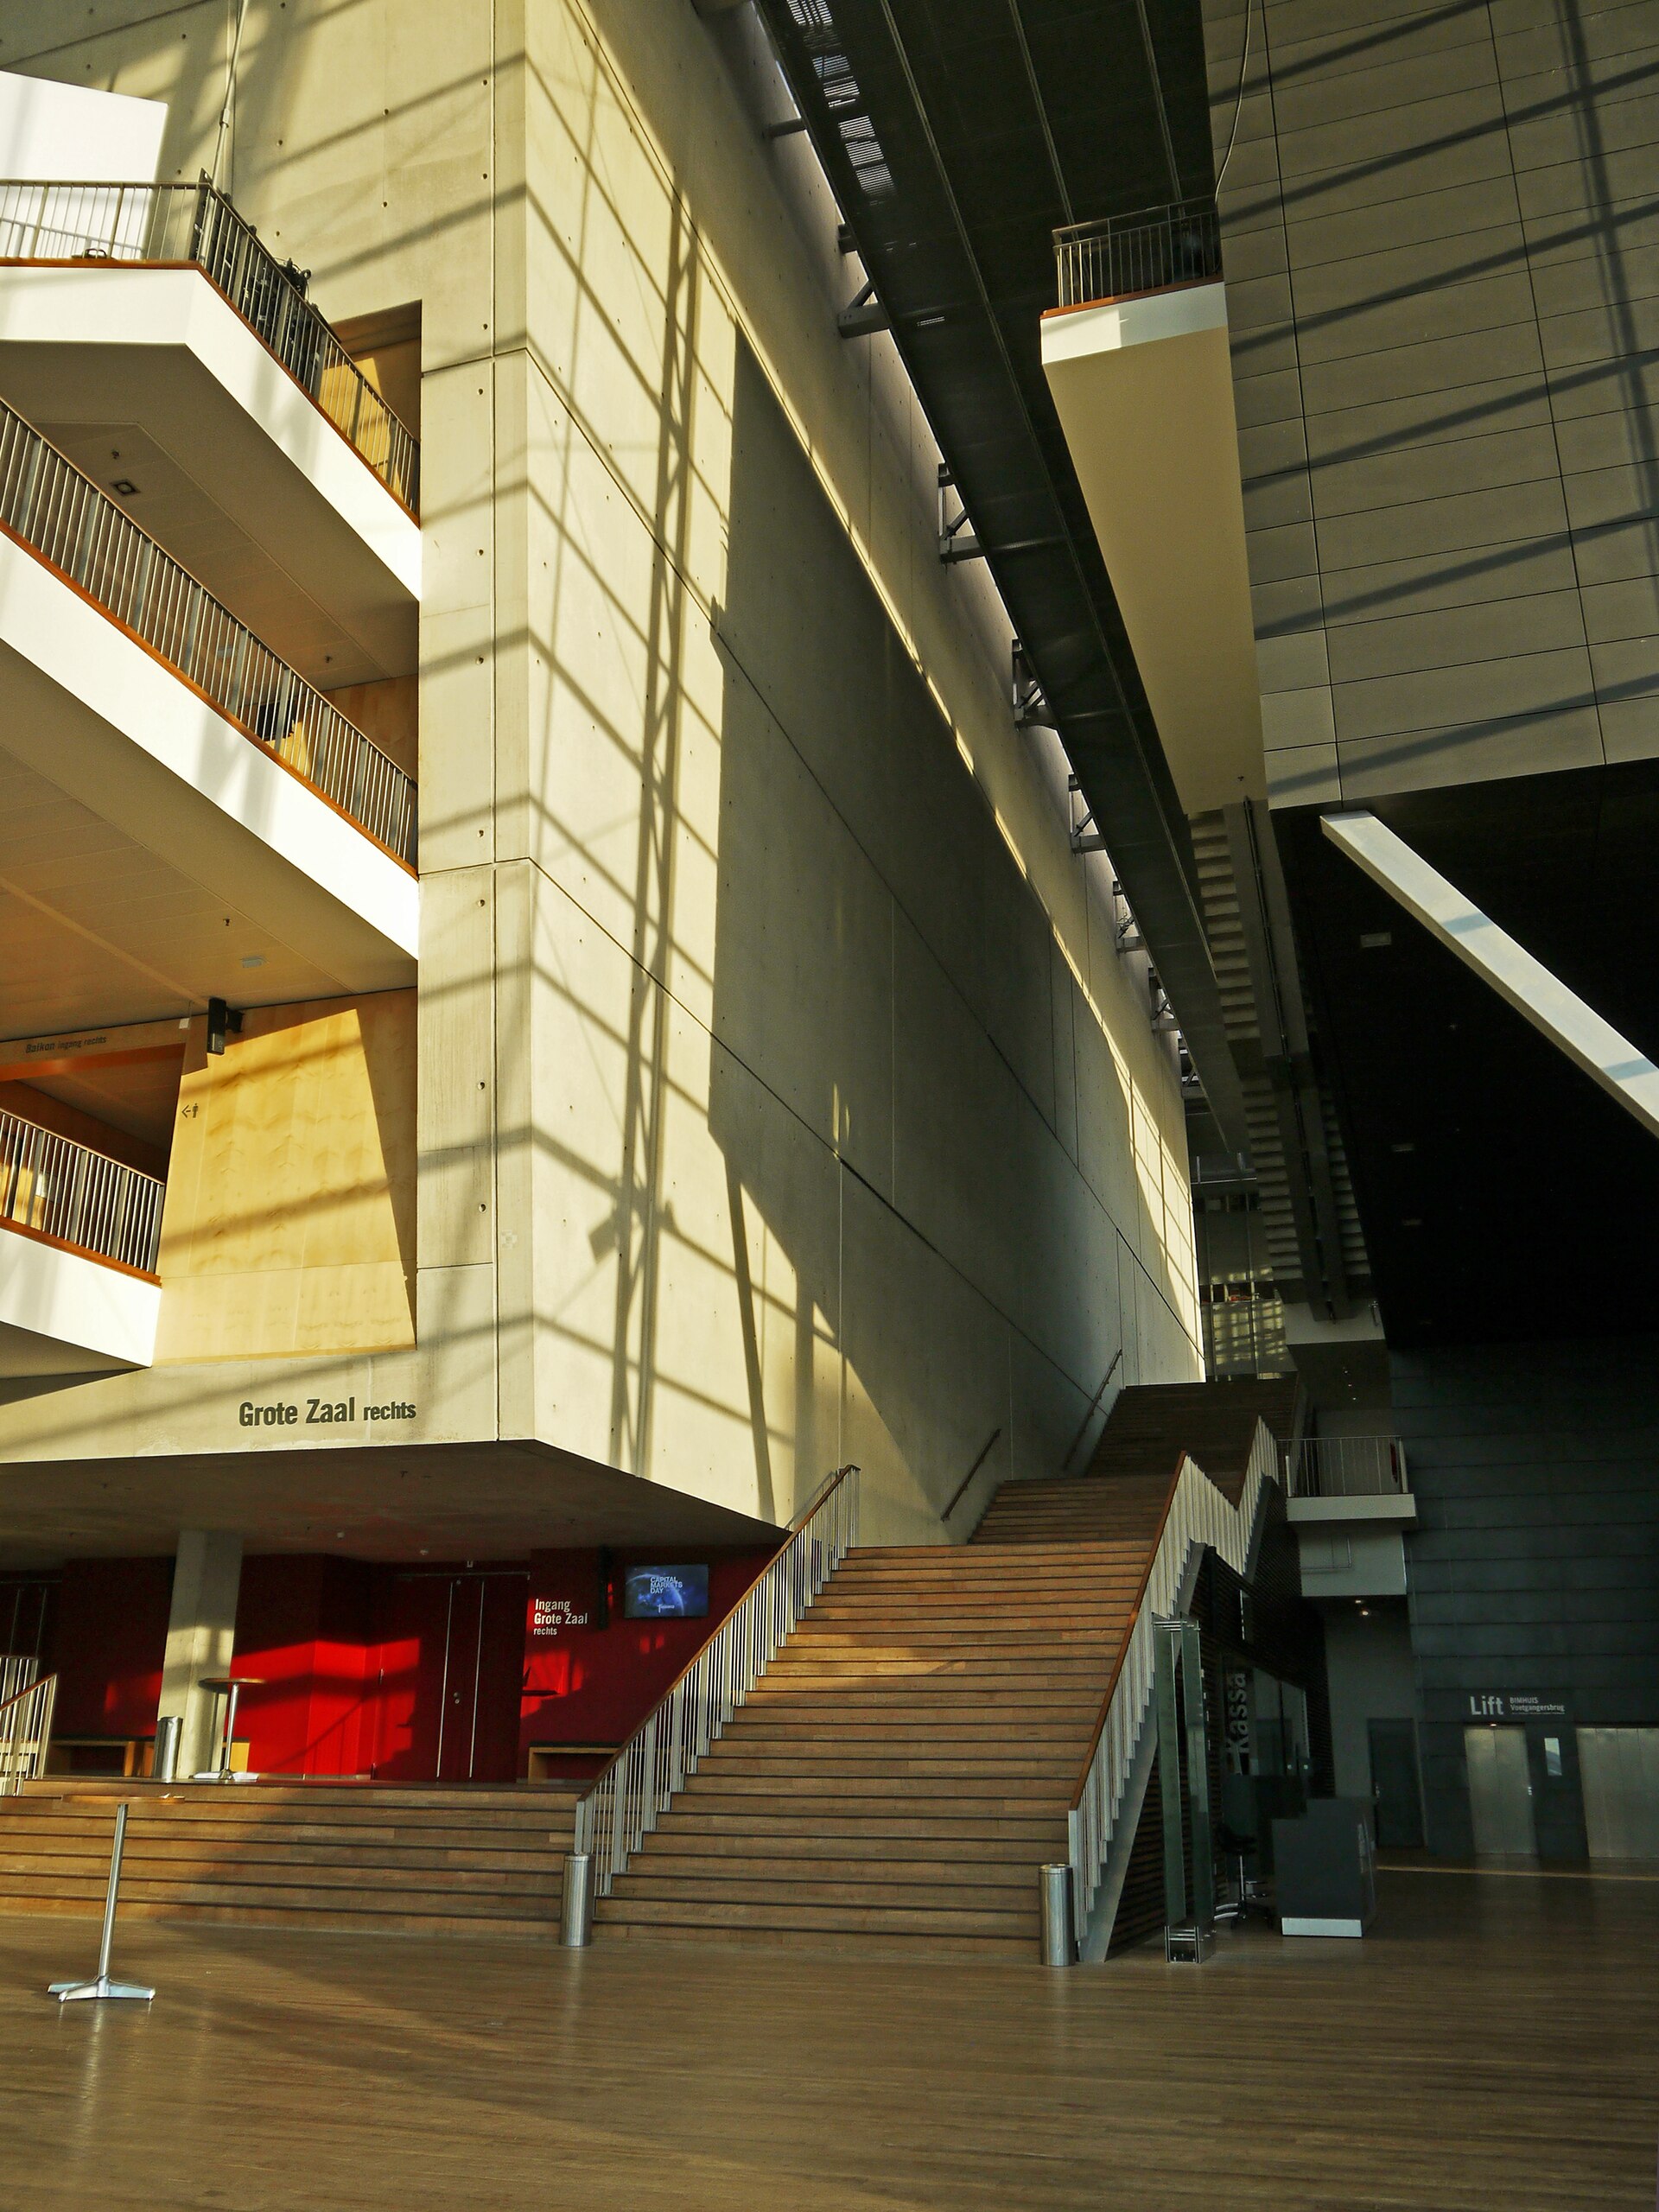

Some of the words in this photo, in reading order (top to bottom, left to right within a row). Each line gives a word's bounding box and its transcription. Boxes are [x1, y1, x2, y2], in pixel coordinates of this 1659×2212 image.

[25, 1042, 55, 1053] Balkon
[238, 1402, 298, 1427] Grote
[305, 1396, 355, 1424] Zaal
[363, 1401, 417, 1421] rechts
[535, 1598, 571, 1613] Ingang
[534, 1611, 562, 1624] Grote
[564, 1612, 588, 1624] Zaal
[533, 1626, 558, 1636] rechts
[1470, 1695, 1504, 1716] Lift
[1510, 1704, 1566, 1713] Voetgangersbrug
[1225, 1673, 1249, 1754] Kassa
